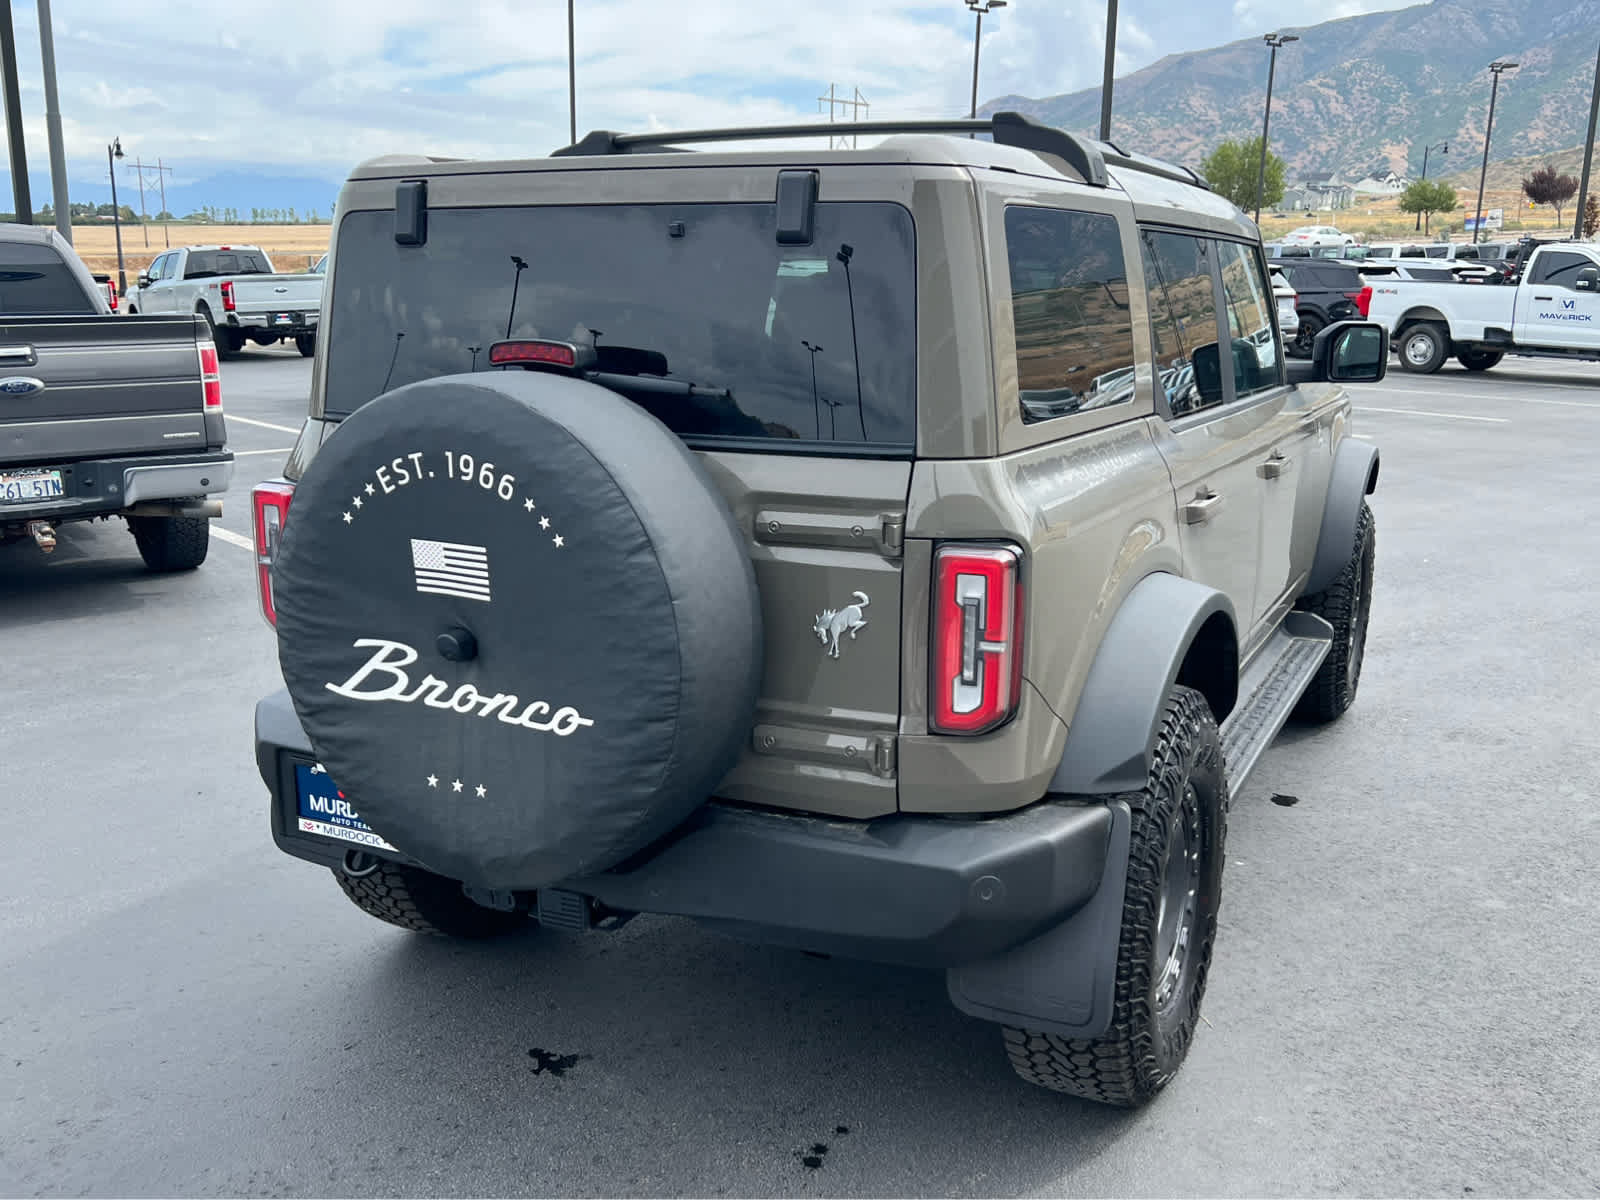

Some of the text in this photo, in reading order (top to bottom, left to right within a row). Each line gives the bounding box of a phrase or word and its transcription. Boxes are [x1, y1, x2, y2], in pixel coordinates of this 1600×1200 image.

[375, 451, 516, 501] EST. 1966
[325, 638, 594, 736] Bronco
[309, 793, 359, 819] MURD
[330, 816, 351, 826] AUTO
[322, 825, 382, 846] MURDOCK
